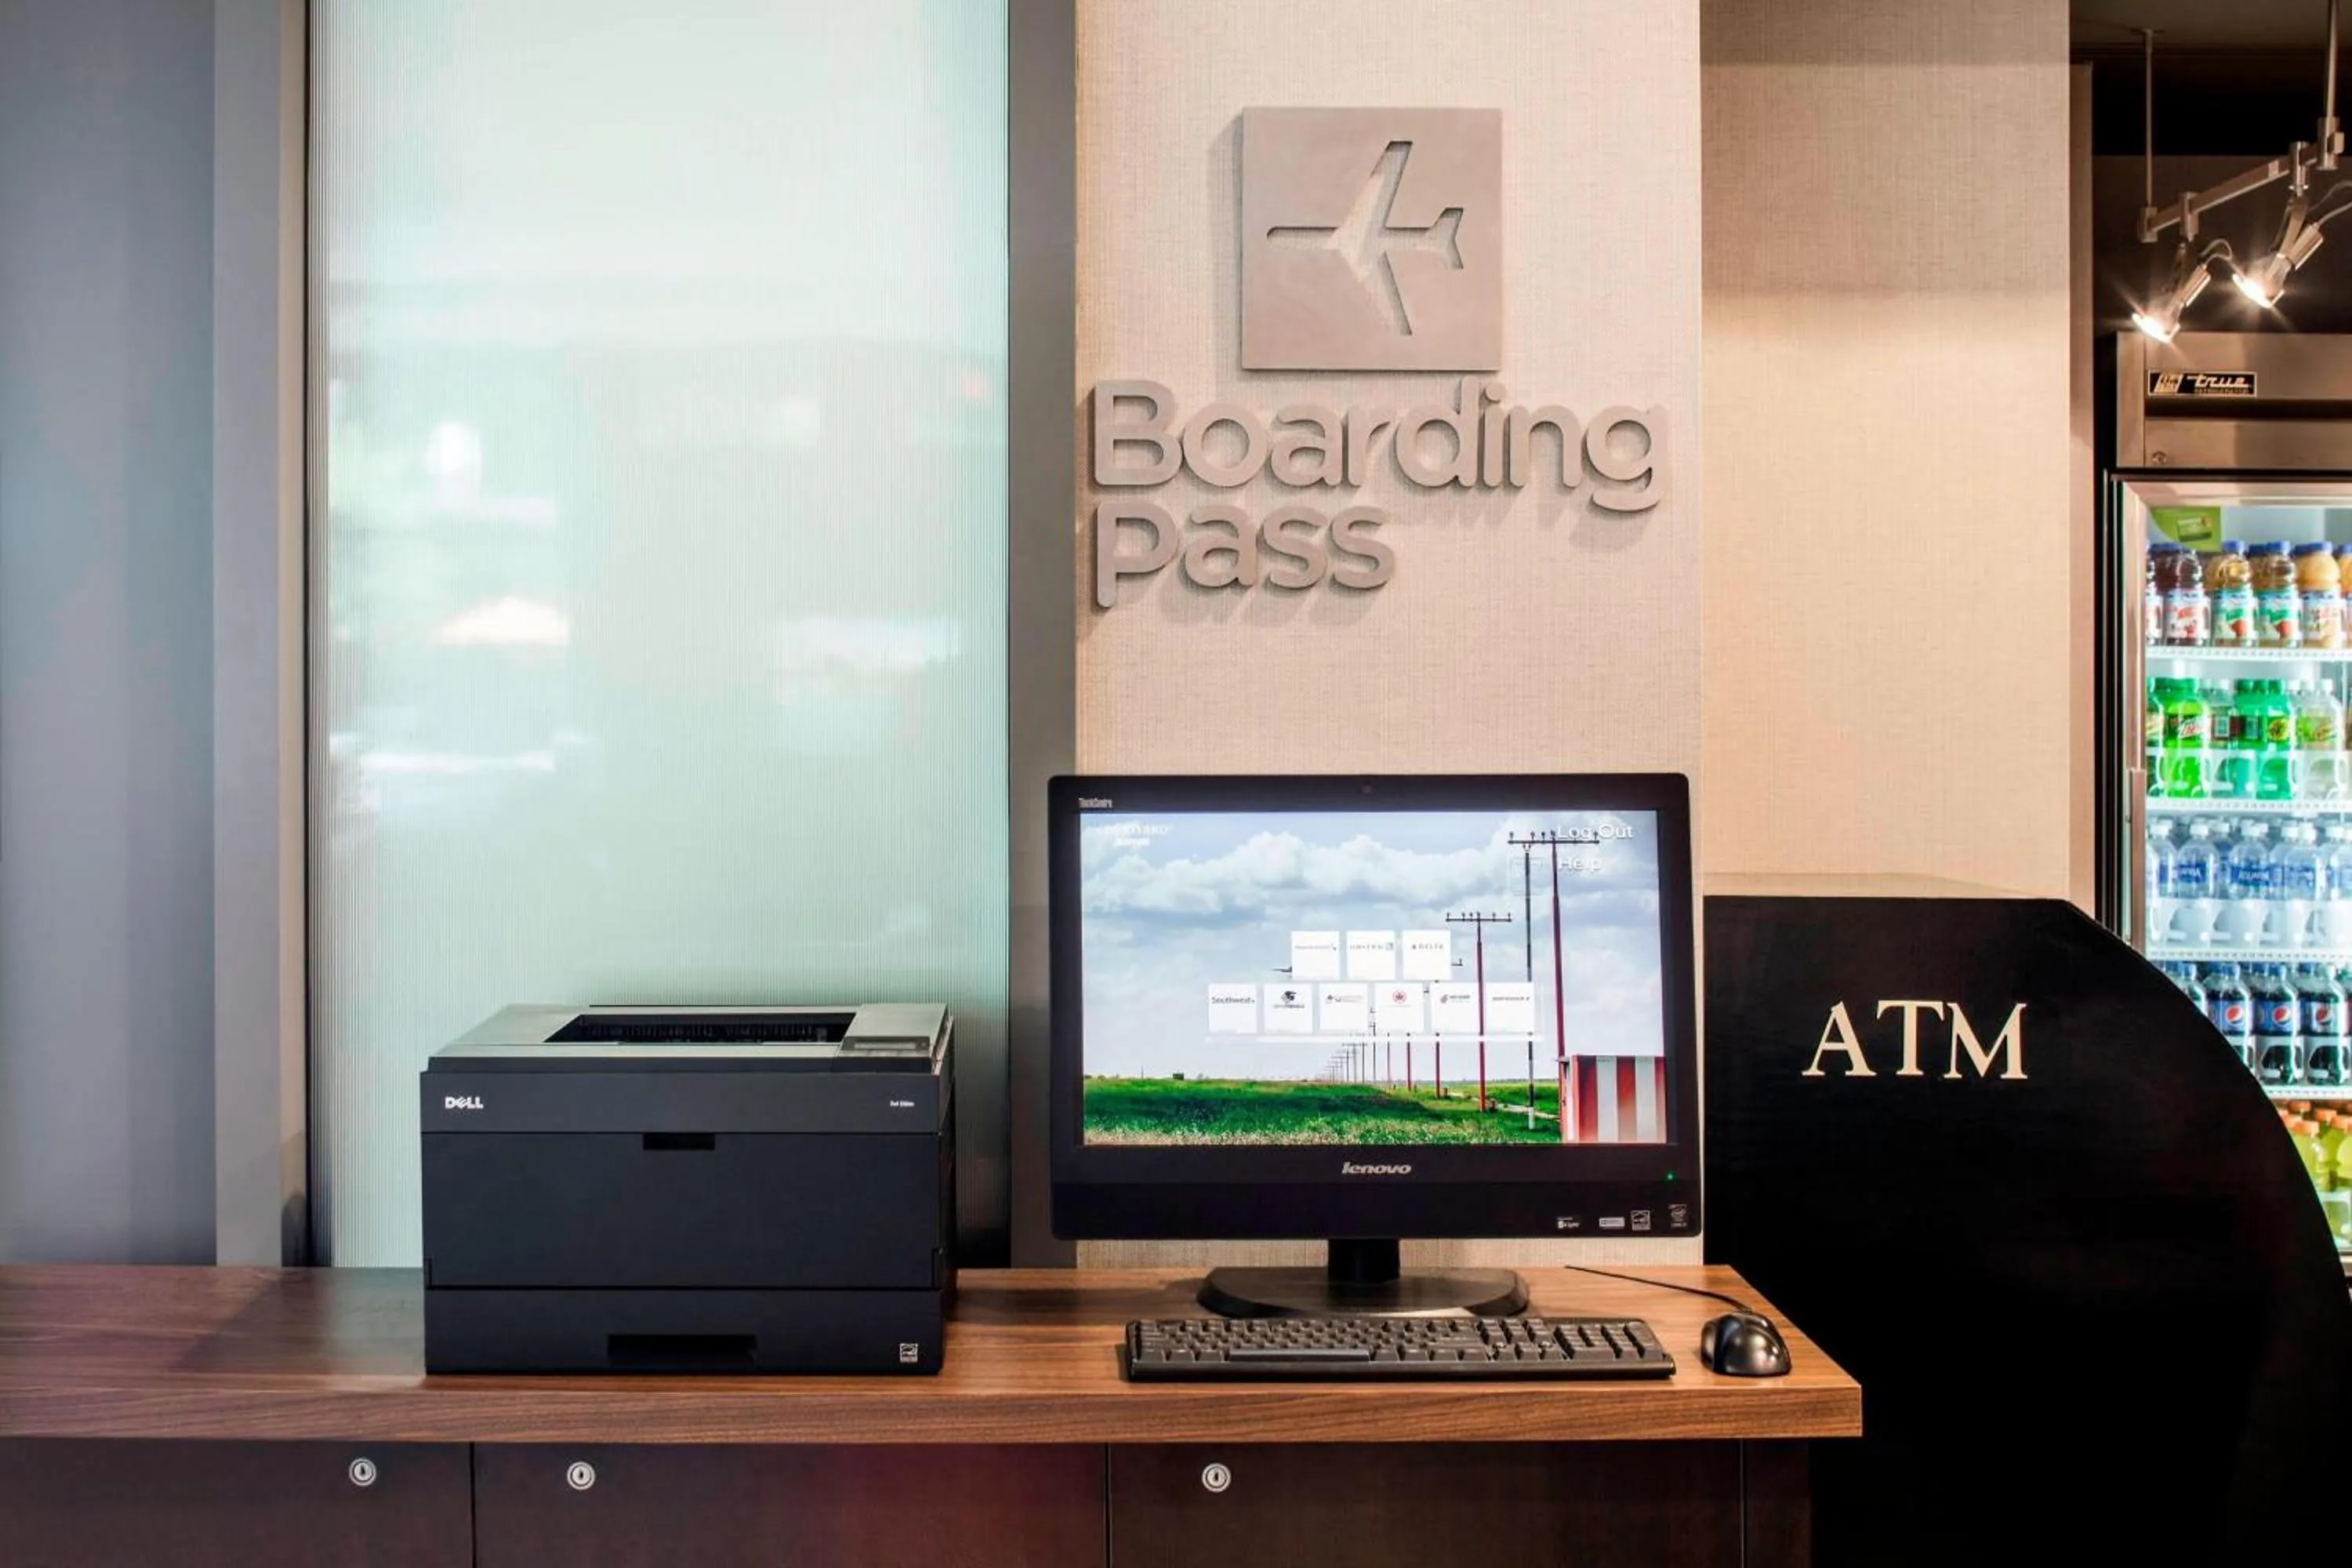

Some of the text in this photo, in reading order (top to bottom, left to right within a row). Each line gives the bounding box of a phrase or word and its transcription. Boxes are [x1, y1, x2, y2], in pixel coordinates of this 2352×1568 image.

[2187, 374, 2249, 388] true
[1094, 376, 1668, 512] Boarding
[1094, 500, 1395, 608] Pass
[1558, 824, 1633, 843] Log Out
[1559, 856, 1602, 871] Help
[1802, 1000, 2029, 1080] ATM
[445, 1096, 484, 1109] DELL
[1341, 1161, 1412, 1174] lenovo
